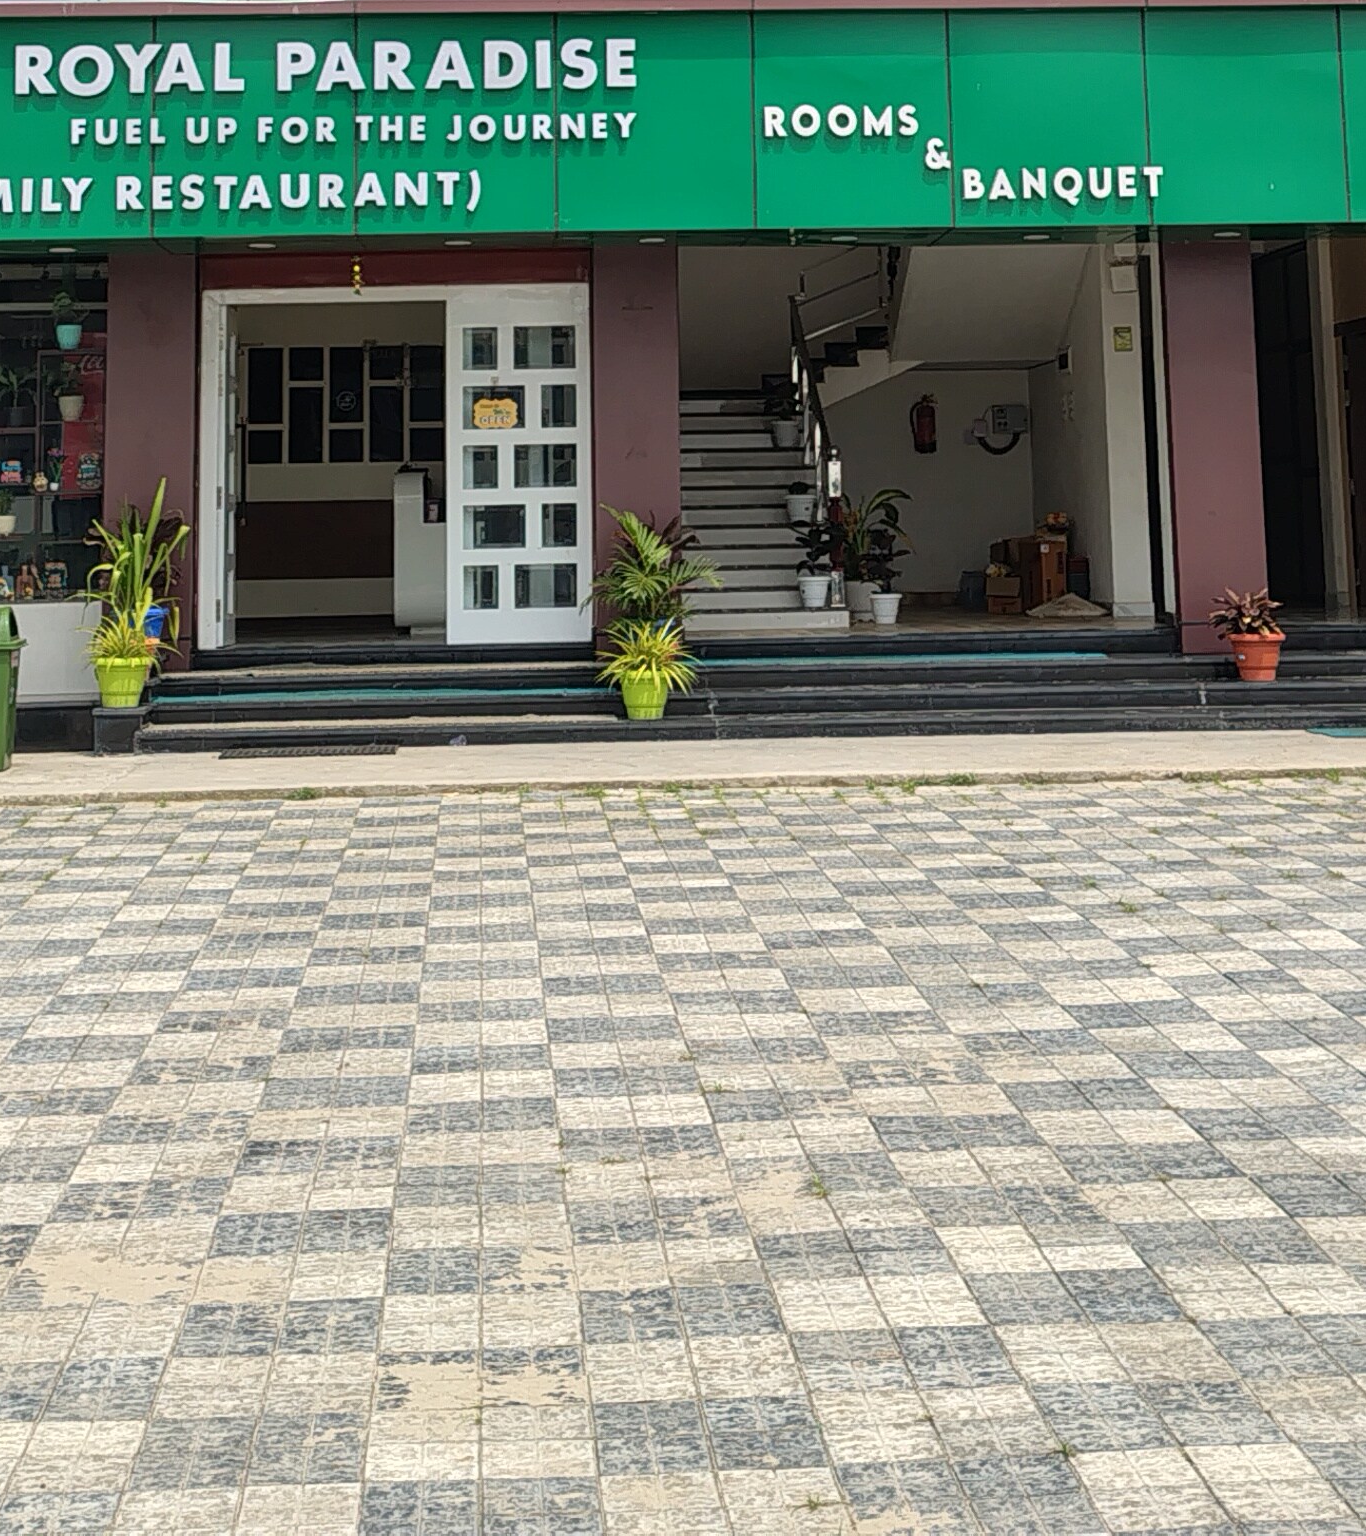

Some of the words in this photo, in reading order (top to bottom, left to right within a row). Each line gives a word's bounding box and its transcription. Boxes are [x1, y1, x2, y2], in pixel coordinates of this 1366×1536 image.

[16, 42, 245, 97] ROYAL
[277, 38, 637, 91] PARADISE
[71, 118, 166, 145] FUEL
[186, 117, 237, 144] UP
[257, 116, 336, 144] FOR
[355, 115, 426, 142] THE
[446, 112, 636, 142] JOURNEY
[763, 104, 919, 137] ROOMS
[925, 137, 952, 170] &
[116, 170, 481, 213] RESTAURANT)
[962, 166, 1163, 205] BANQUET
